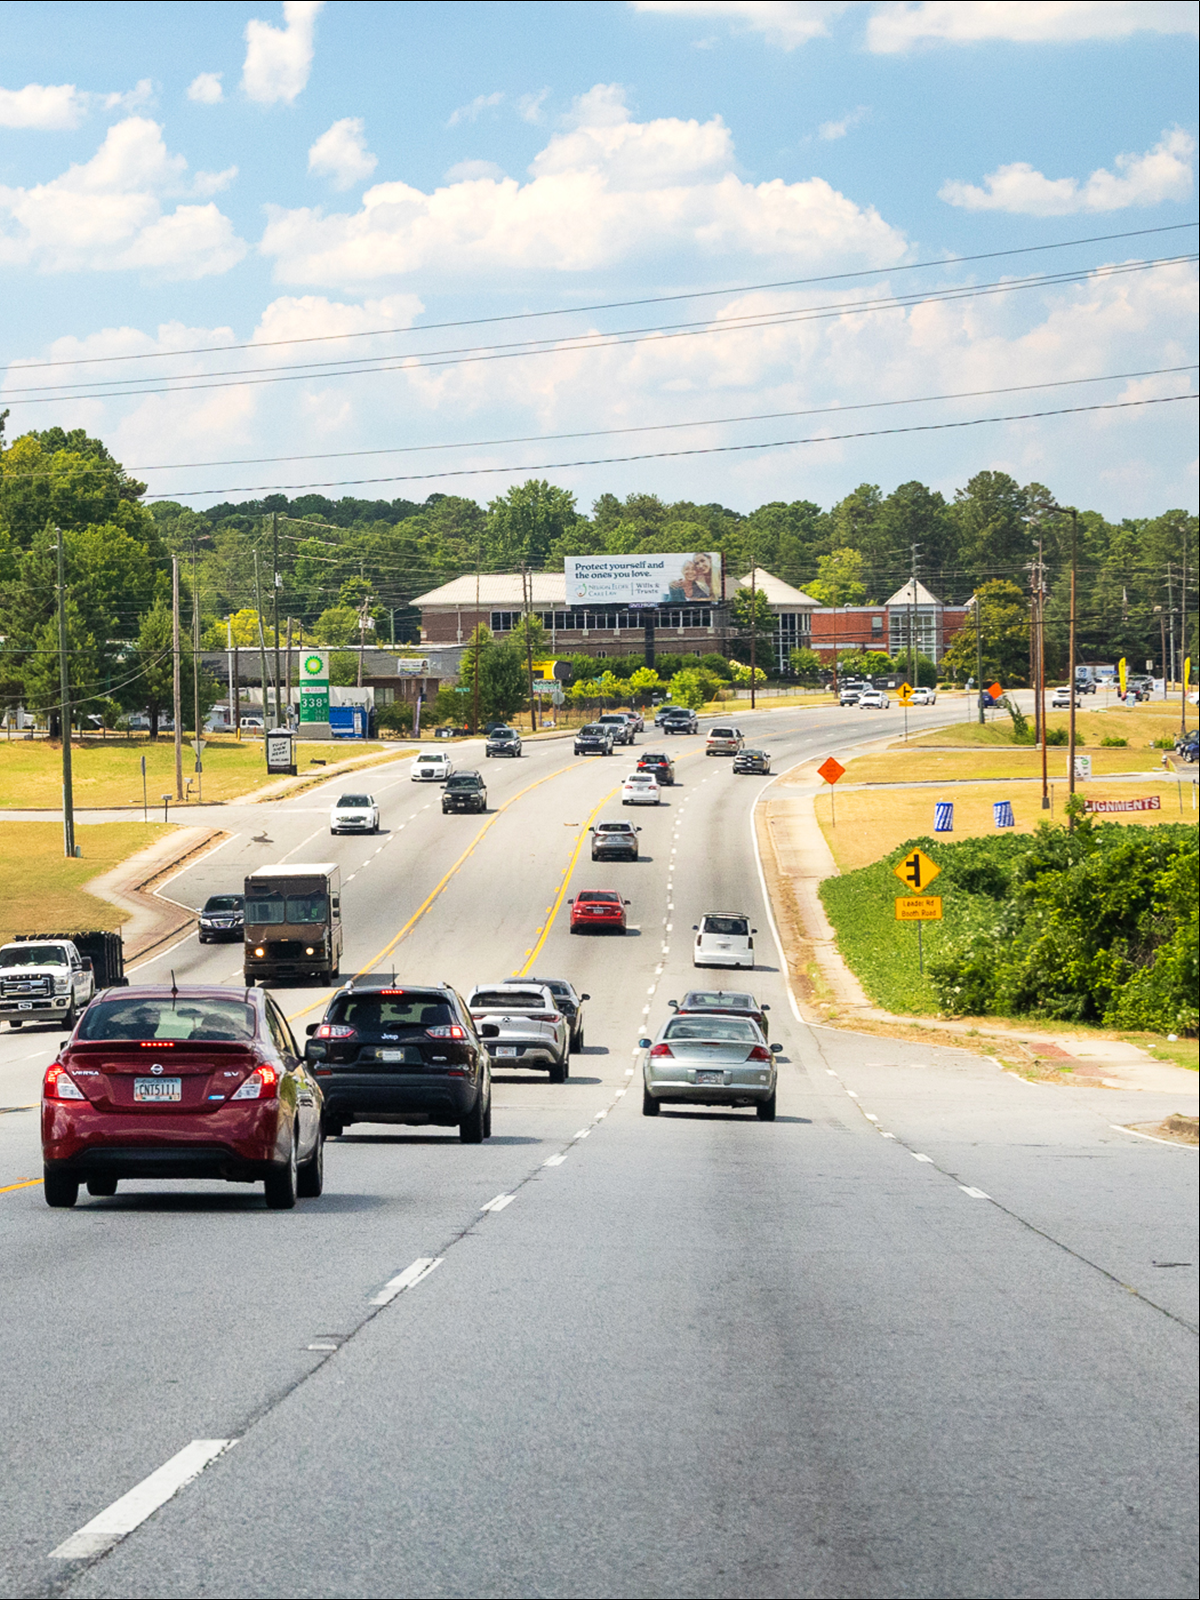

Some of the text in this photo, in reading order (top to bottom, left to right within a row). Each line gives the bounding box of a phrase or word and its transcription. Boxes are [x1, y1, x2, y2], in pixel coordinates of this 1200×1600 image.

[575, 561, 664, 571] Protect yourself and
[575, 570, 652, 580] the ones you love.
[1084, 796, 1160, 812] LIGNMENTS
